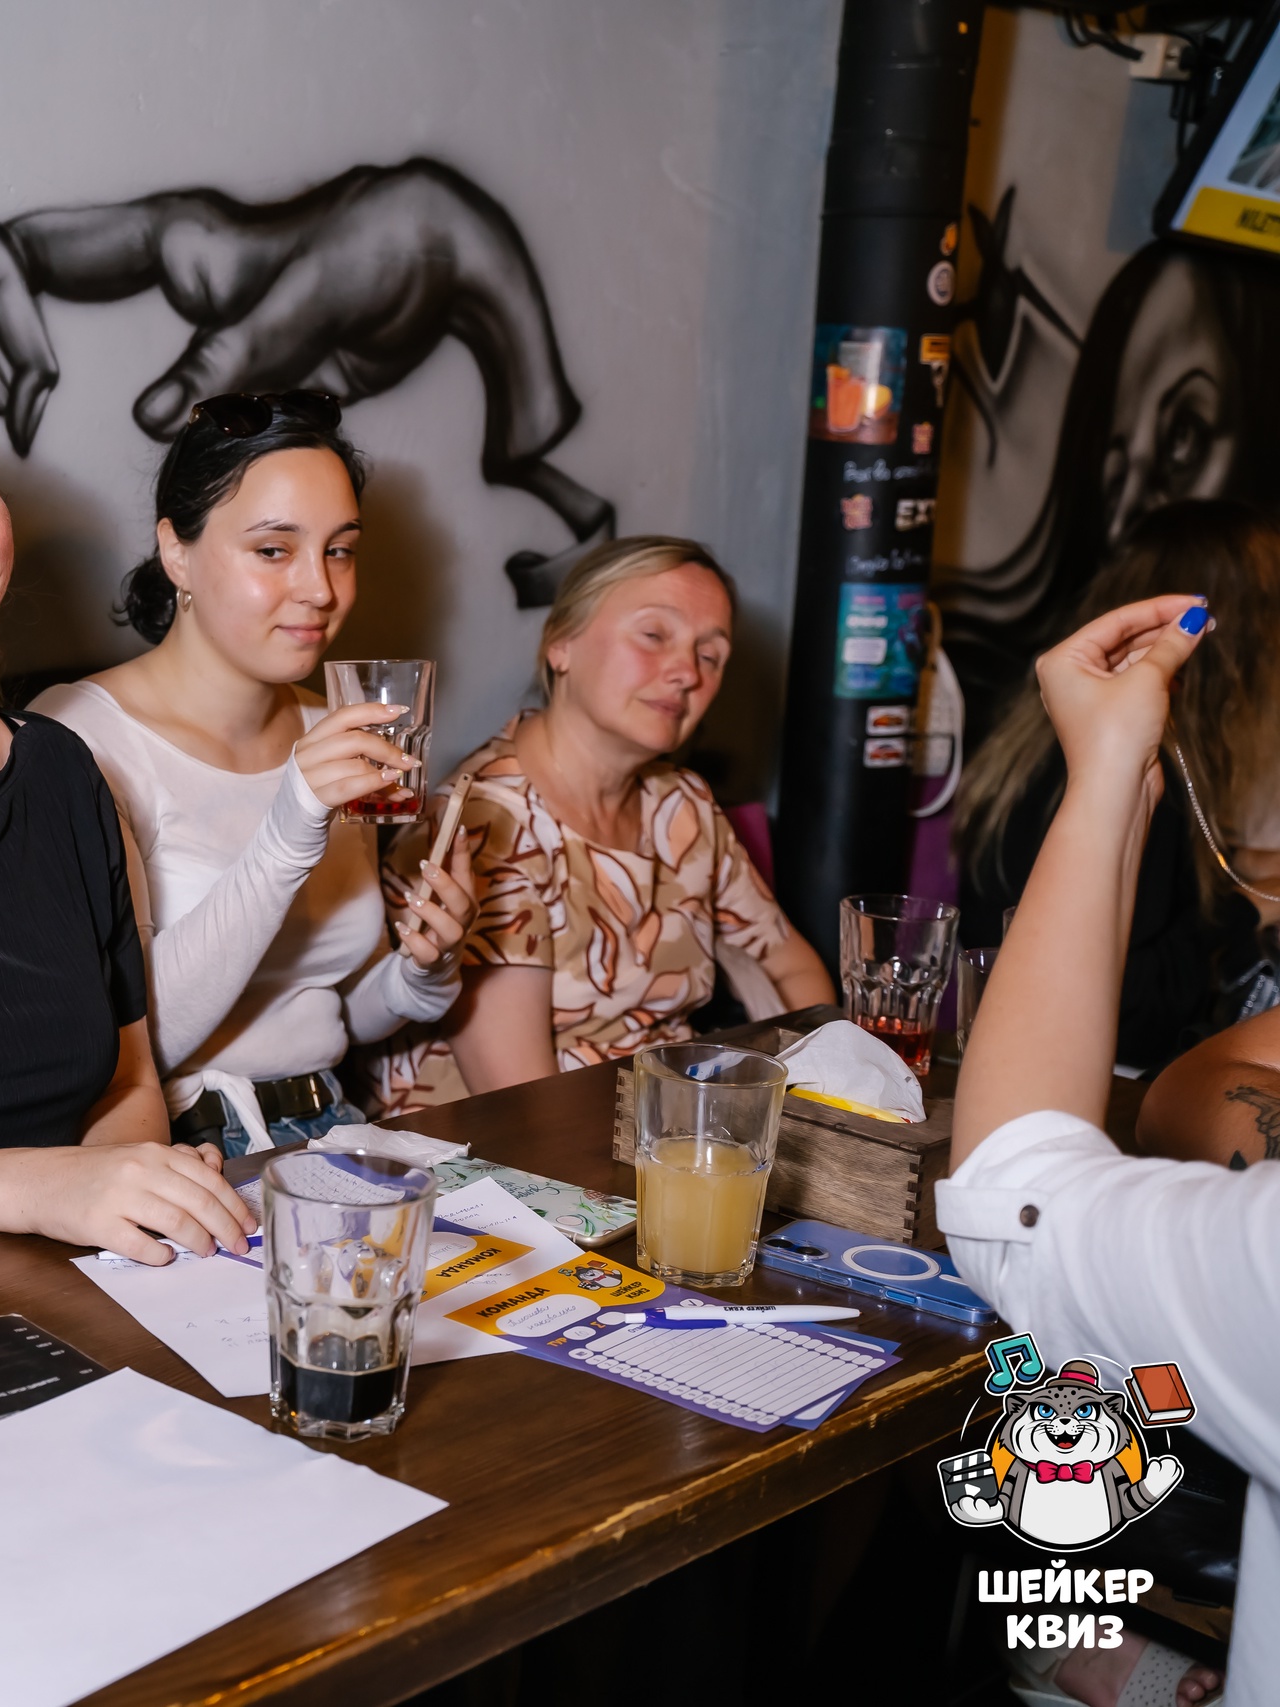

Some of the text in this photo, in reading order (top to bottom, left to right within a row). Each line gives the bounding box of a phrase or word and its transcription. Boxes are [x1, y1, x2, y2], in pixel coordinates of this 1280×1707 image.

[436, 1248, 502, 1278] КОМАНДА
[610, 1281, 642, 1297] ШЕЙКЕР
[625, 1288, 650, 1299] КВИЗ
[476, 1287, 551, 1318] КОМАНДА
